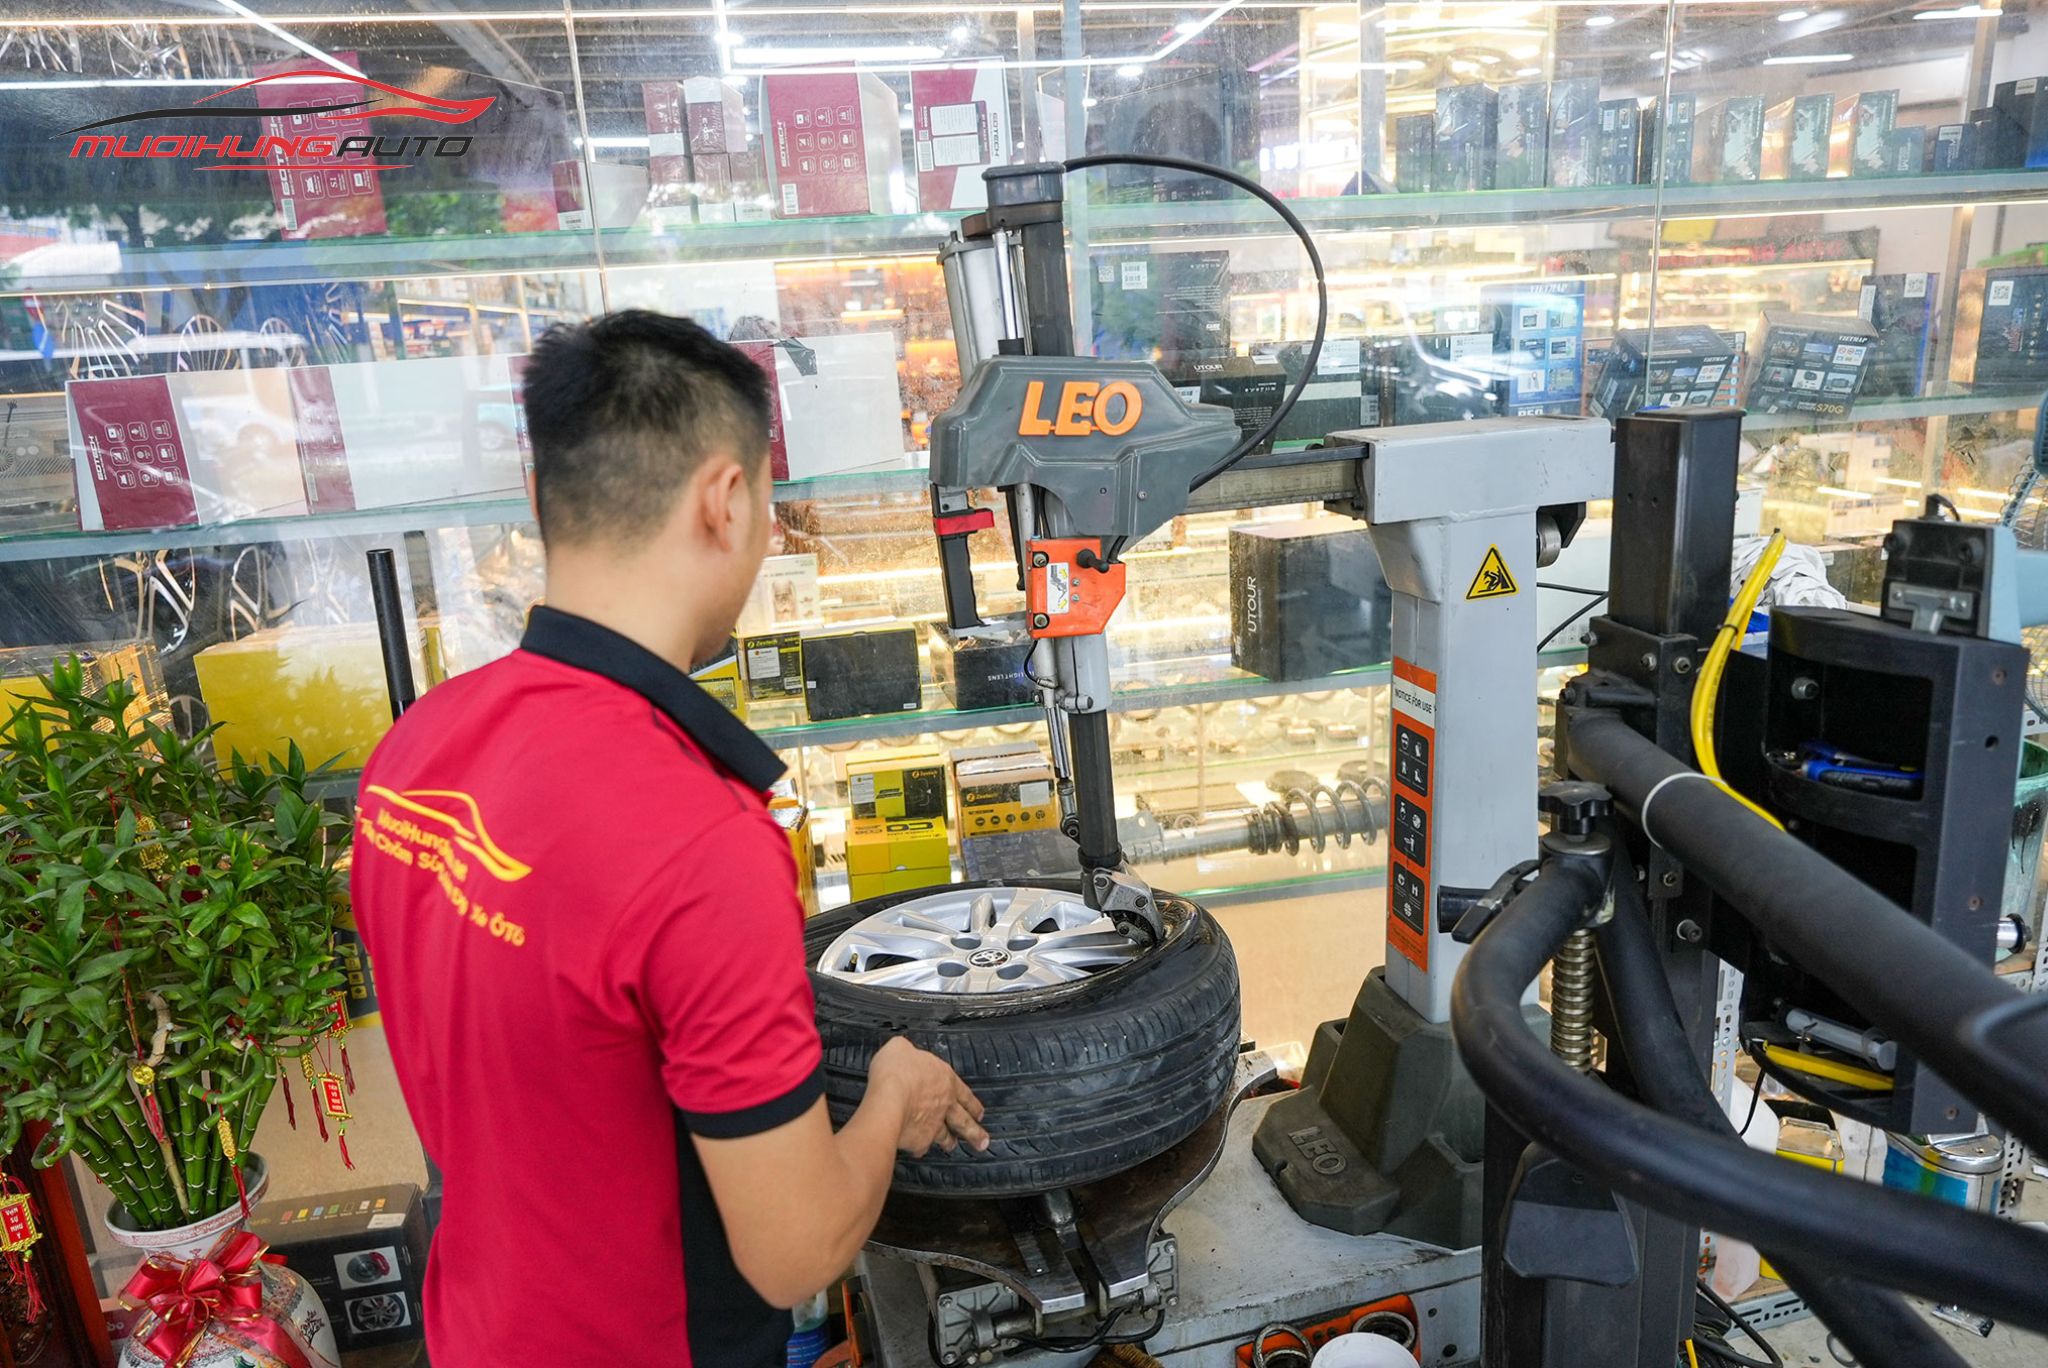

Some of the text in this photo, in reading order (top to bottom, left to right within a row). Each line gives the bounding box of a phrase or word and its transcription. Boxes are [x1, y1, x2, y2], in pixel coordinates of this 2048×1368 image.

[1193, 363, 1223, 371] UTOUR
[1018, 381, 1142, 436] LEO
[1247, 576, 1257, 633] UTOUR
[1394, 688, 1432, 714] NOTICE FOR USE
[1288, 1126, 1346, 1175] LEO
